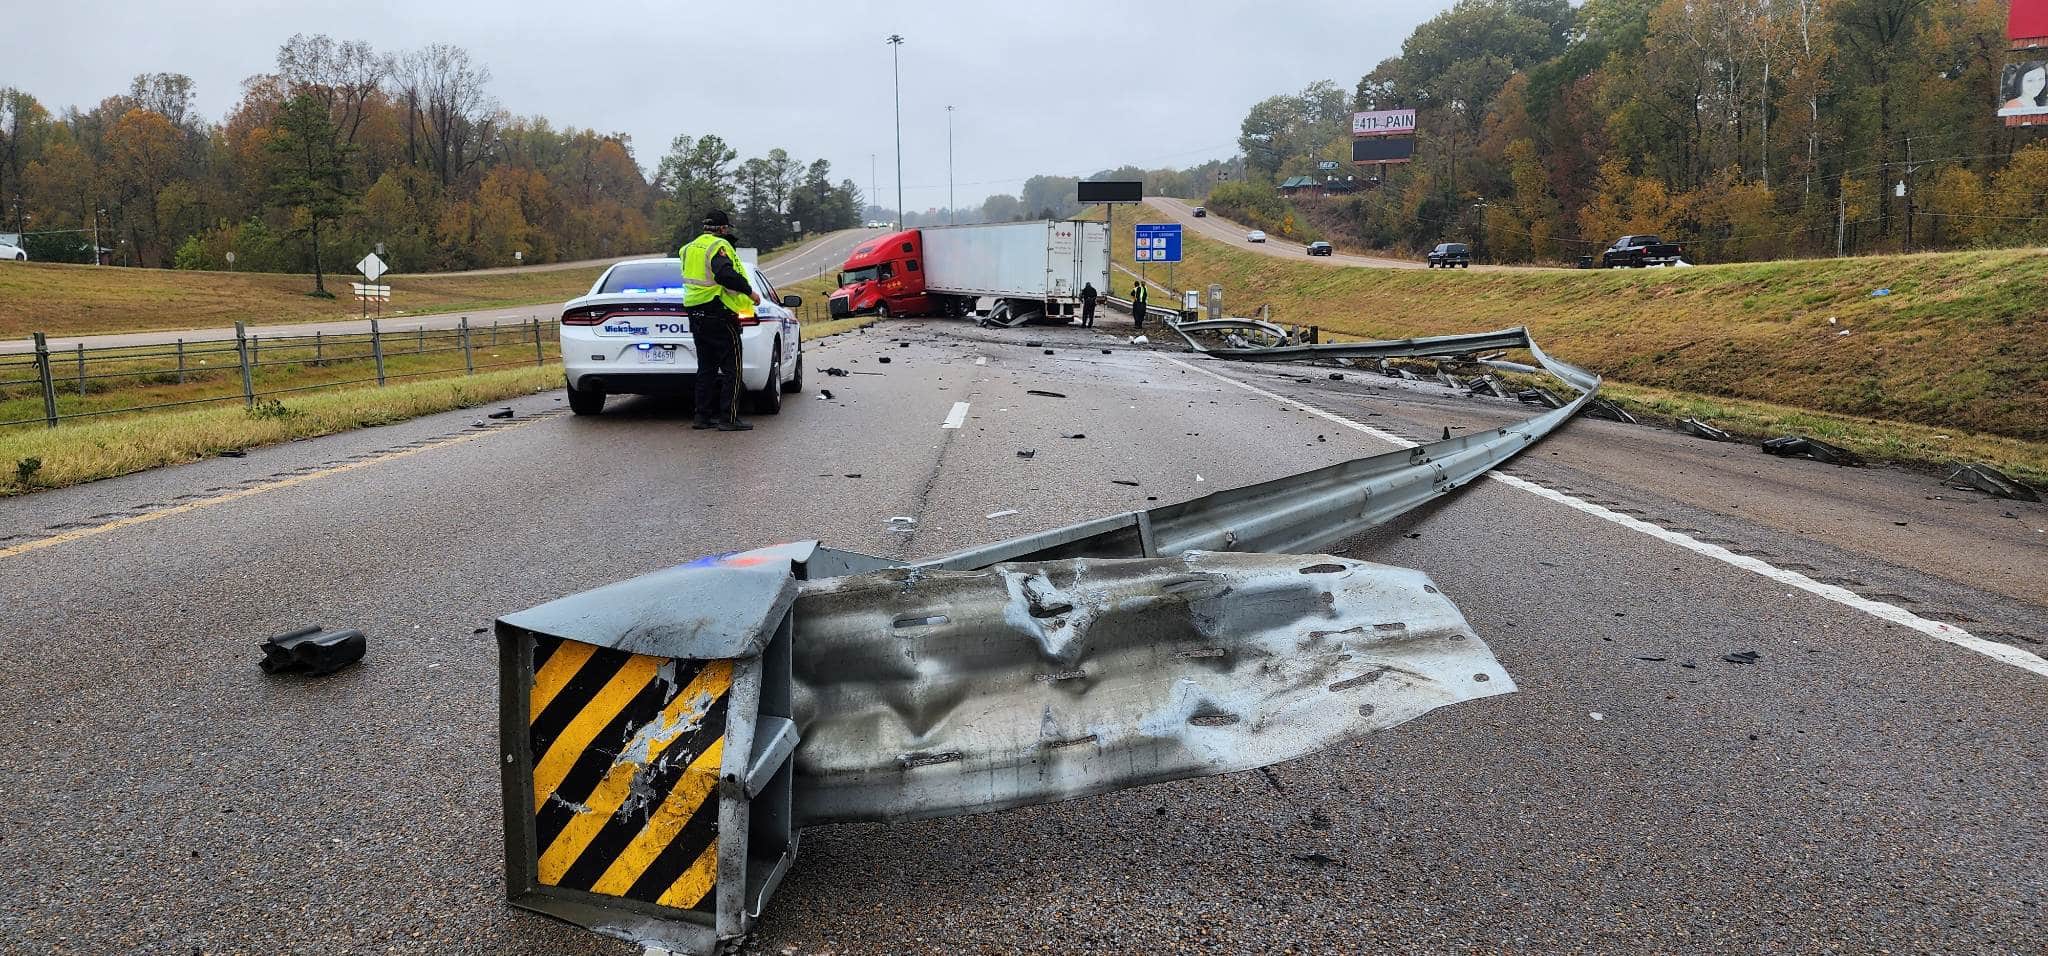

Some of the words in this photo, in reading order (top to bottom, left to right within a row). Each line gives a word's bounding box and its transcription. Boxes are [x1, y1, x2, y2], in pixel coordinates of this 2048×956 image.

[1386, 114, 1414, 128] PAIN
[604, 325, 649, 335] Vicksburg
[659, 323, 689, 333] POL
